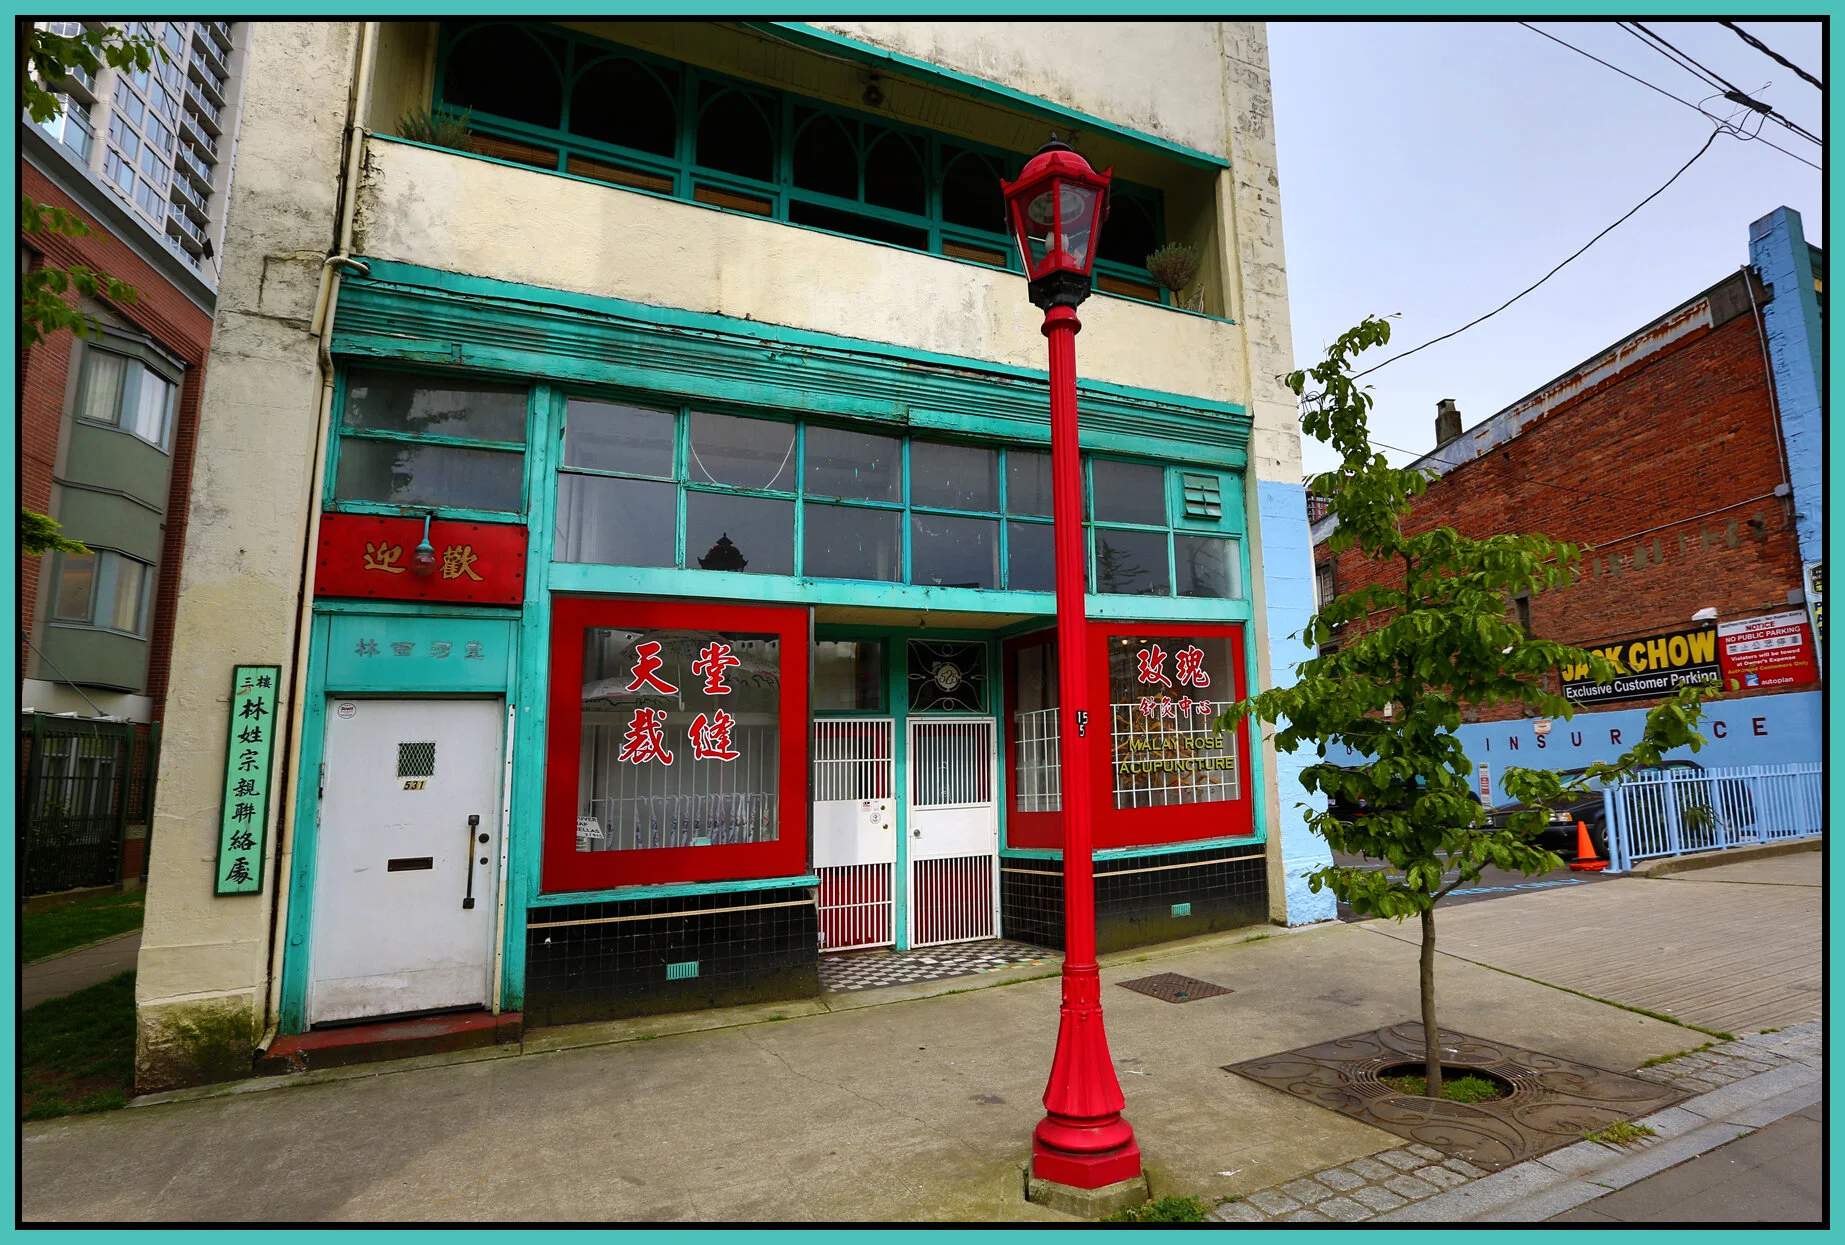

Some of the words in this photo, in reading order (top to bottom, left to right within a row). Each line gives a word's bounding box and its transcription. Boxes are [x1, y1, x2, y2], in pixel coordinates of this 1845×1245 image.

[1737, 631, 1764, 641] PUBLIC
[1766, 626, 1801, 635] PARKING
[1745, 622, 1775, 631] NOTICE
[1628, 630, 1716, 672] CHOW
[1136, 643, 1211, 688] 玫瑰
[1760, 662, 1793, 671] Customers
[1769, 655, 1797, 663] Expense
[625, 640, 741, 695] 天堂
[239, 675, 273, 689] 三樓
[939, 669, 958, 685] 525
[1761, 677, 1794, 685] autoplan
[1566, 685, 1613, 699] Exclusive
[1614, 678, 1668, 693] Customer
[1139, 696, 1211, 718] 針灸中心
[1077, 711, 1089, 725] 15
[617, 706, 741, 767] 裁縫
[1079, 724, 1085, 737] 5
[1485, 717, 1769, 752] INSURCE
[1128, 740, 1178, 752] MALAY
[1183, 737, 1224, 750] ROSE
[1119, 757, 1235, 775] ACUPUNCTURE
[404, 780, 425, 791] 531
